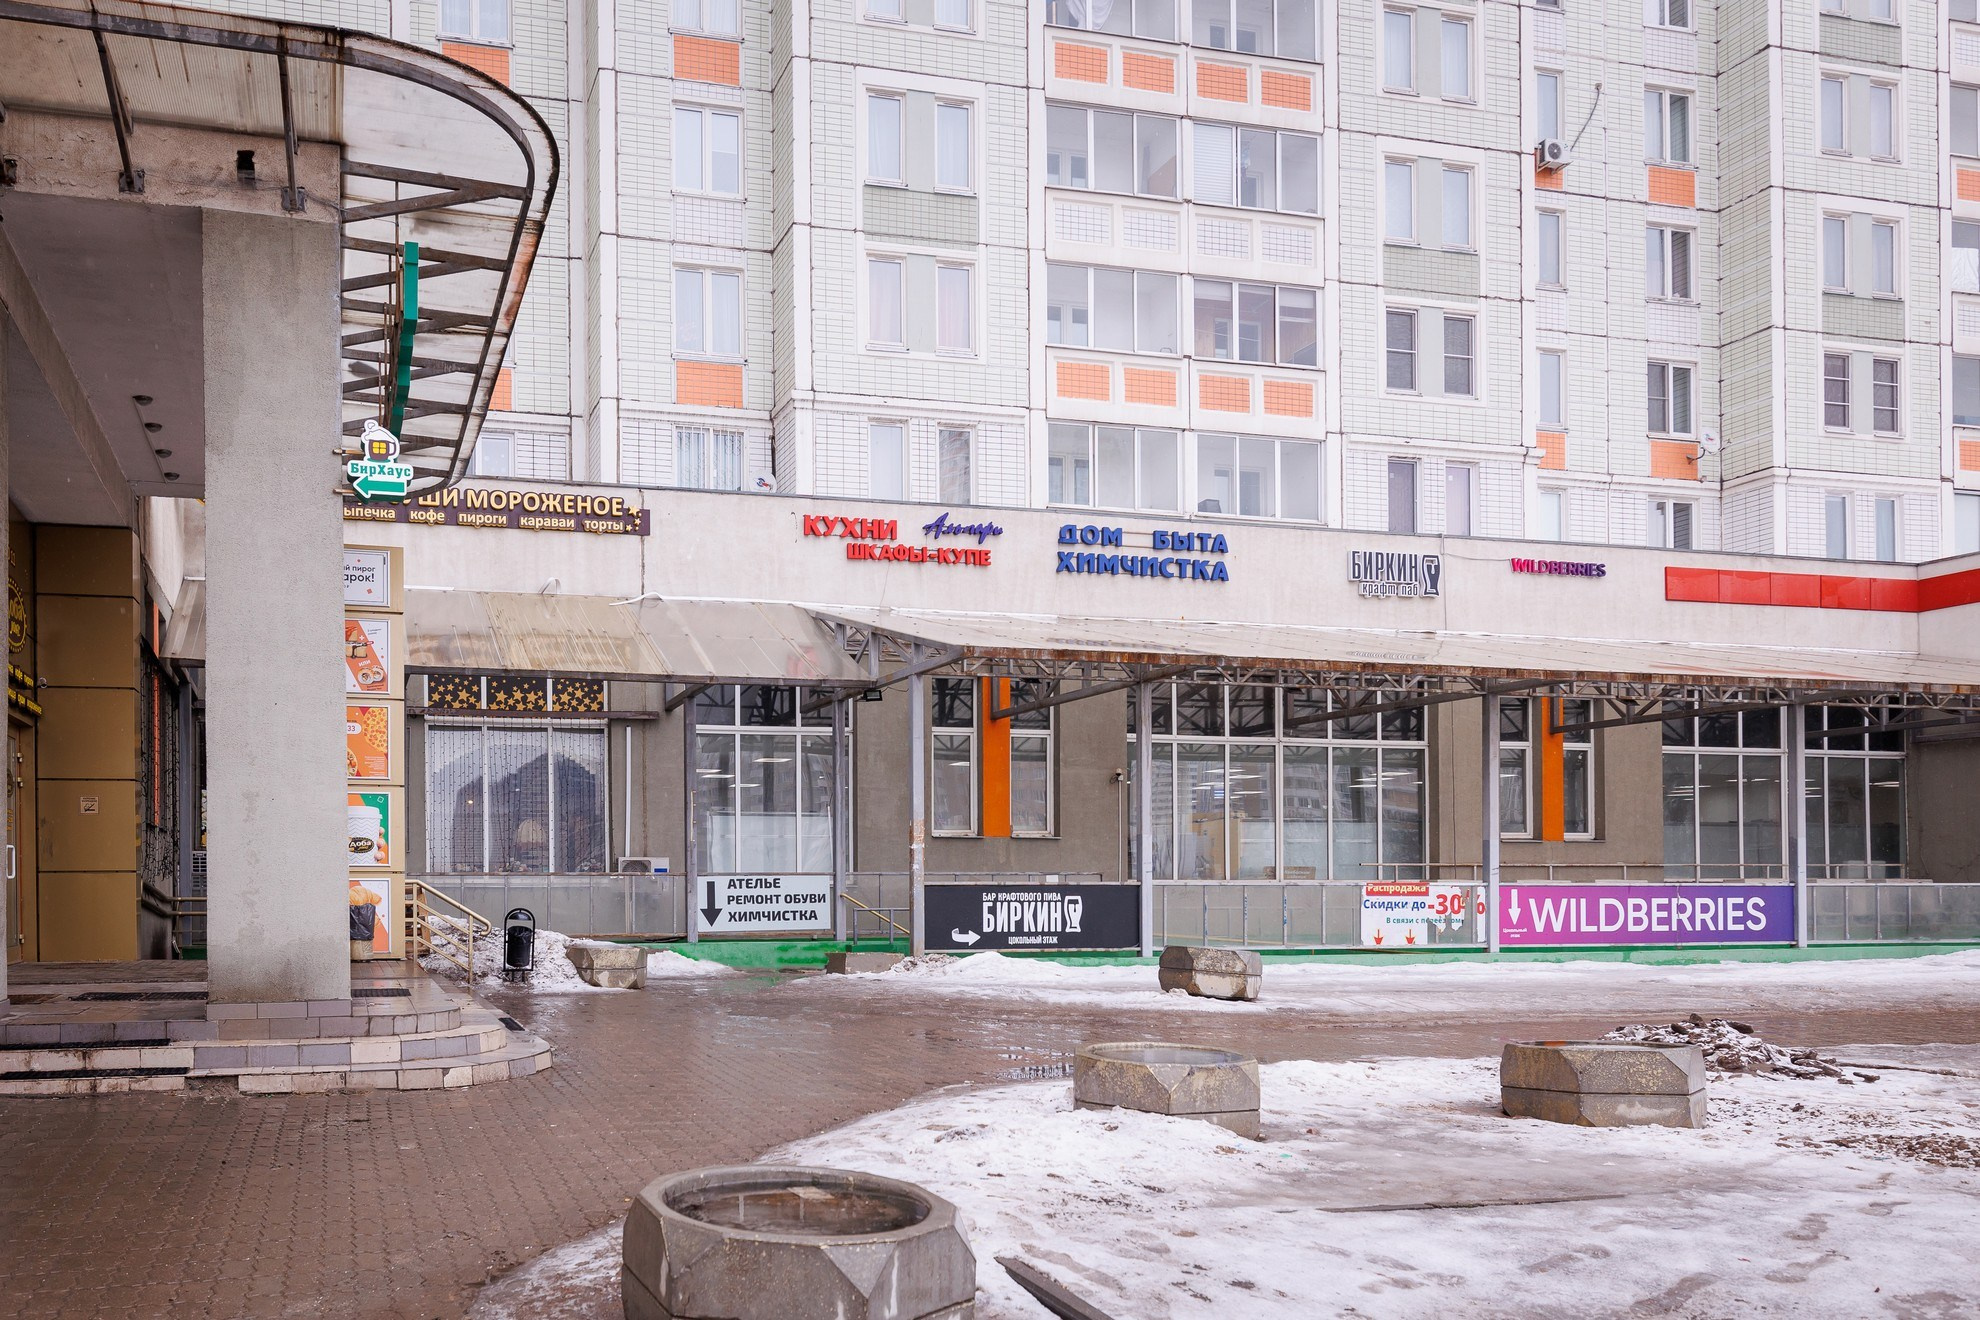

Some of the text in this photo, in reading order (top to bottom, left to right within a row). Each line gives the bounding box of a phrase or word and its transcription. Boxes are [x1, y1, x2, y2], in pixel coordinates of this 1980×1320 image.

[350, 462, 411, 479] БирХаус
[466, 489, 624, 516] МОРОЖЕНОЕ
[343, 507, 624, 532] ыпечка кофе пироги караваи торты
[803, 514, 898, 541] КУХНИ
[1058, 524, 1229, 554] ДОМ БЫТА
[846, 543, 992, 567] ШКАФЫ-КУПЕ
[1056, 551, 1230, 582] ХИМЧИСТКА
[1351, 550, 1418, 582] БИРКИН
[1510, 557, 1607, 577] WILDBERRIES
[344, 573, 375, 583] арок!
[1362, 582, 1418, 597] крафт паб
[727, 878, 781, 889] АТЕЛЬЕ
[1367, 884, 1427, 894] Распродажа
[727, 893, 826, 905] РЕМОНТ ОБУВИ
[982, 892, 1062, 901] БАР КРАФТОВОГО ПИВА
[1363, 899, 1408, 911] Скидки
[1411, 901, 1426, 911] до
[728, 910, 818, 922] ХИМЧИСТКА
[982, 901, 1062, 933] БИРКИН
[1528, 896, 1767, 933] WILDBERRIES
[1008, 935, 1058, 945] ЦОКОЛЬНЫЙ ЭТАЖ
